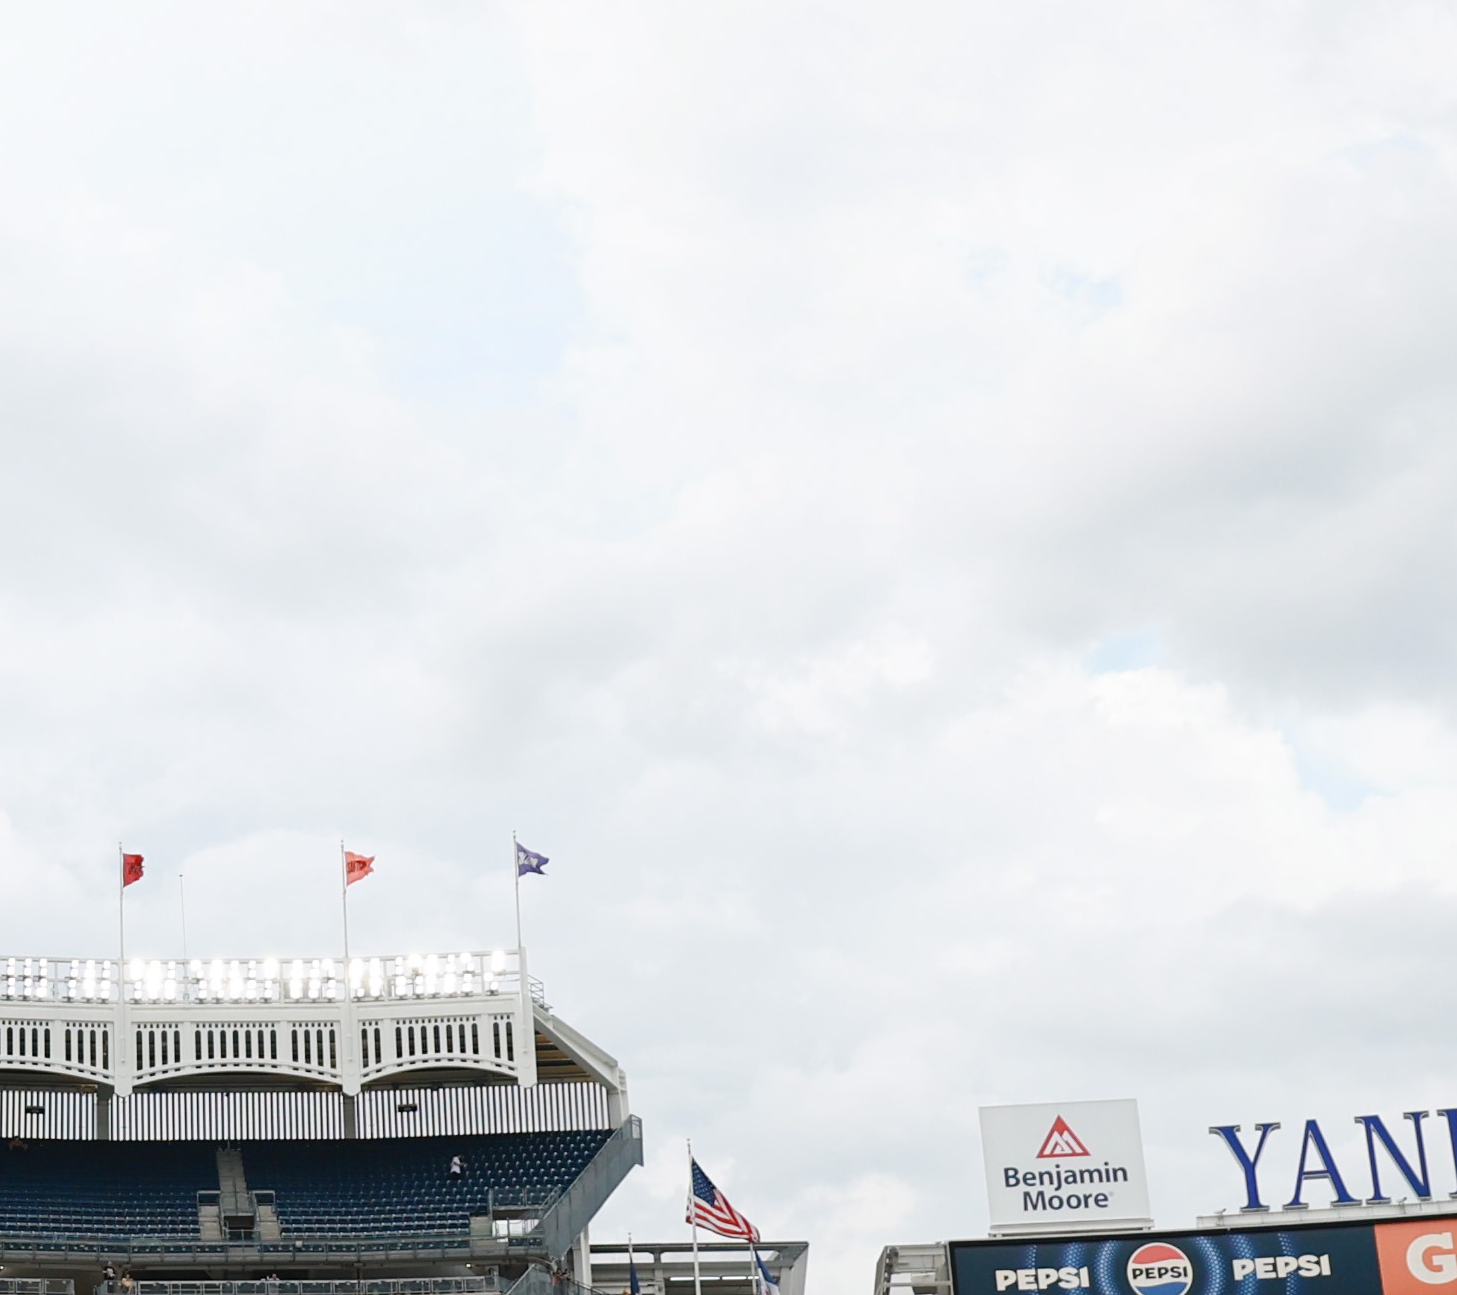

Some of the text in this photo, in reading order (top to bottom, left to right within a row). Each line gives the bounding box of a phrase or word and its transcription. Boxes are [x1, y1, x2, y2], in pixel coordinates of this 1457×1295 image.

[1003, 1161, 1128, 1191] Benjamin
[1022, 1189, 1109, 1212] Moore
[995, 1254, 1332, 1291] PEPSI PEPSI PEPSI
